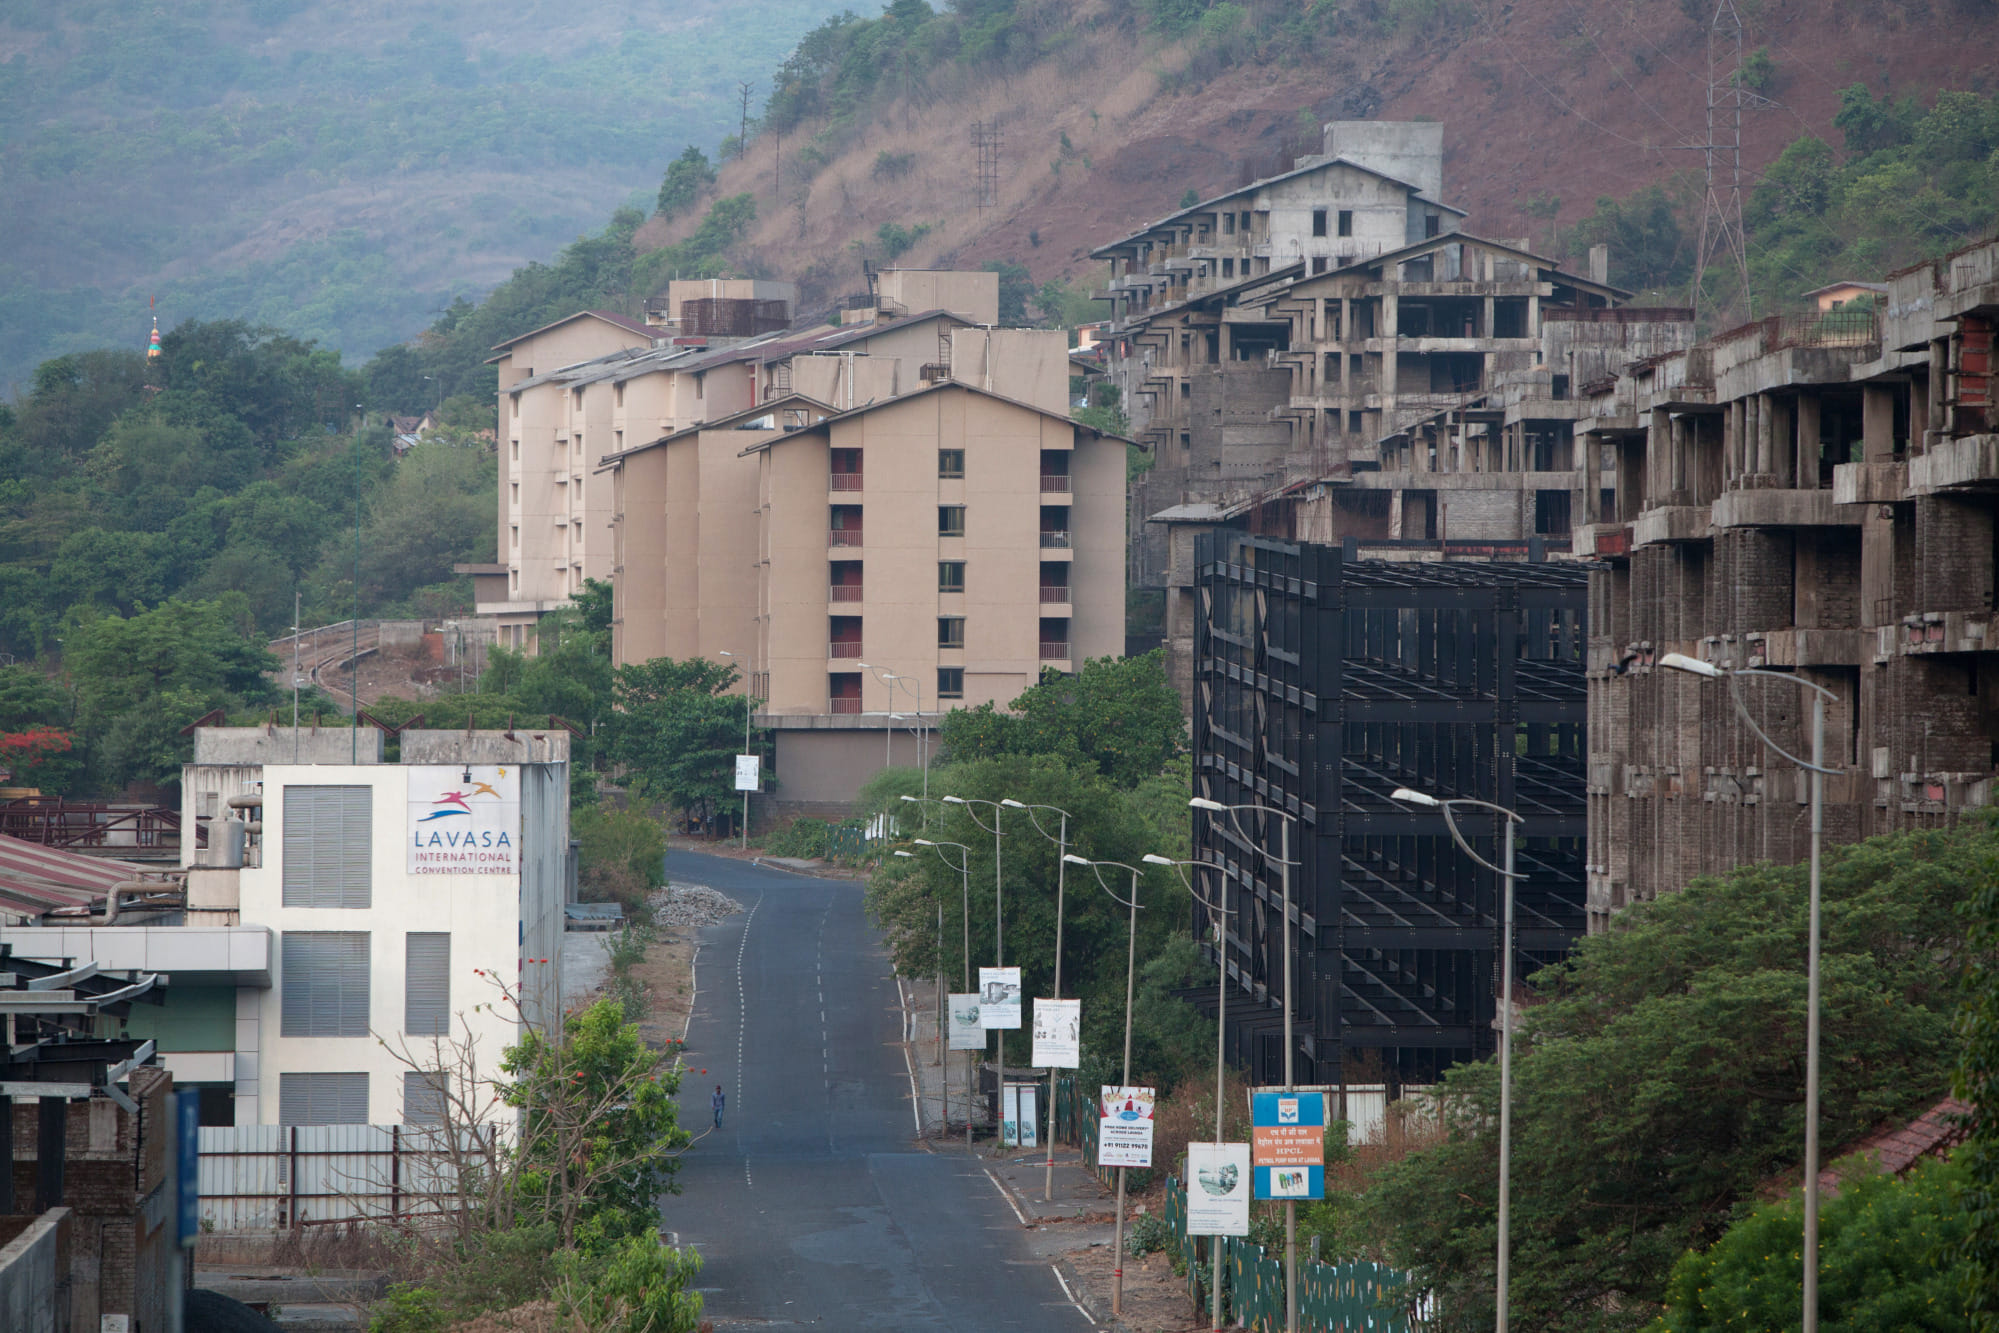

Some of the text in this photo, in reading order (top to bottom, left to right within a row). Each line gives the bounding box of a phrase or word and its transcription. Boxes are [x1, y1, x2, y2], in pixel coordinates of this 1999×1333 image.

[415, 830, 511, 848] LAVASA
[415, 852, 511, 862] INTERNATIONAL
[415, 866, 511, 874] CONVENTION CENTRE
[1276, 1147, 1304, 1155] HPCL
